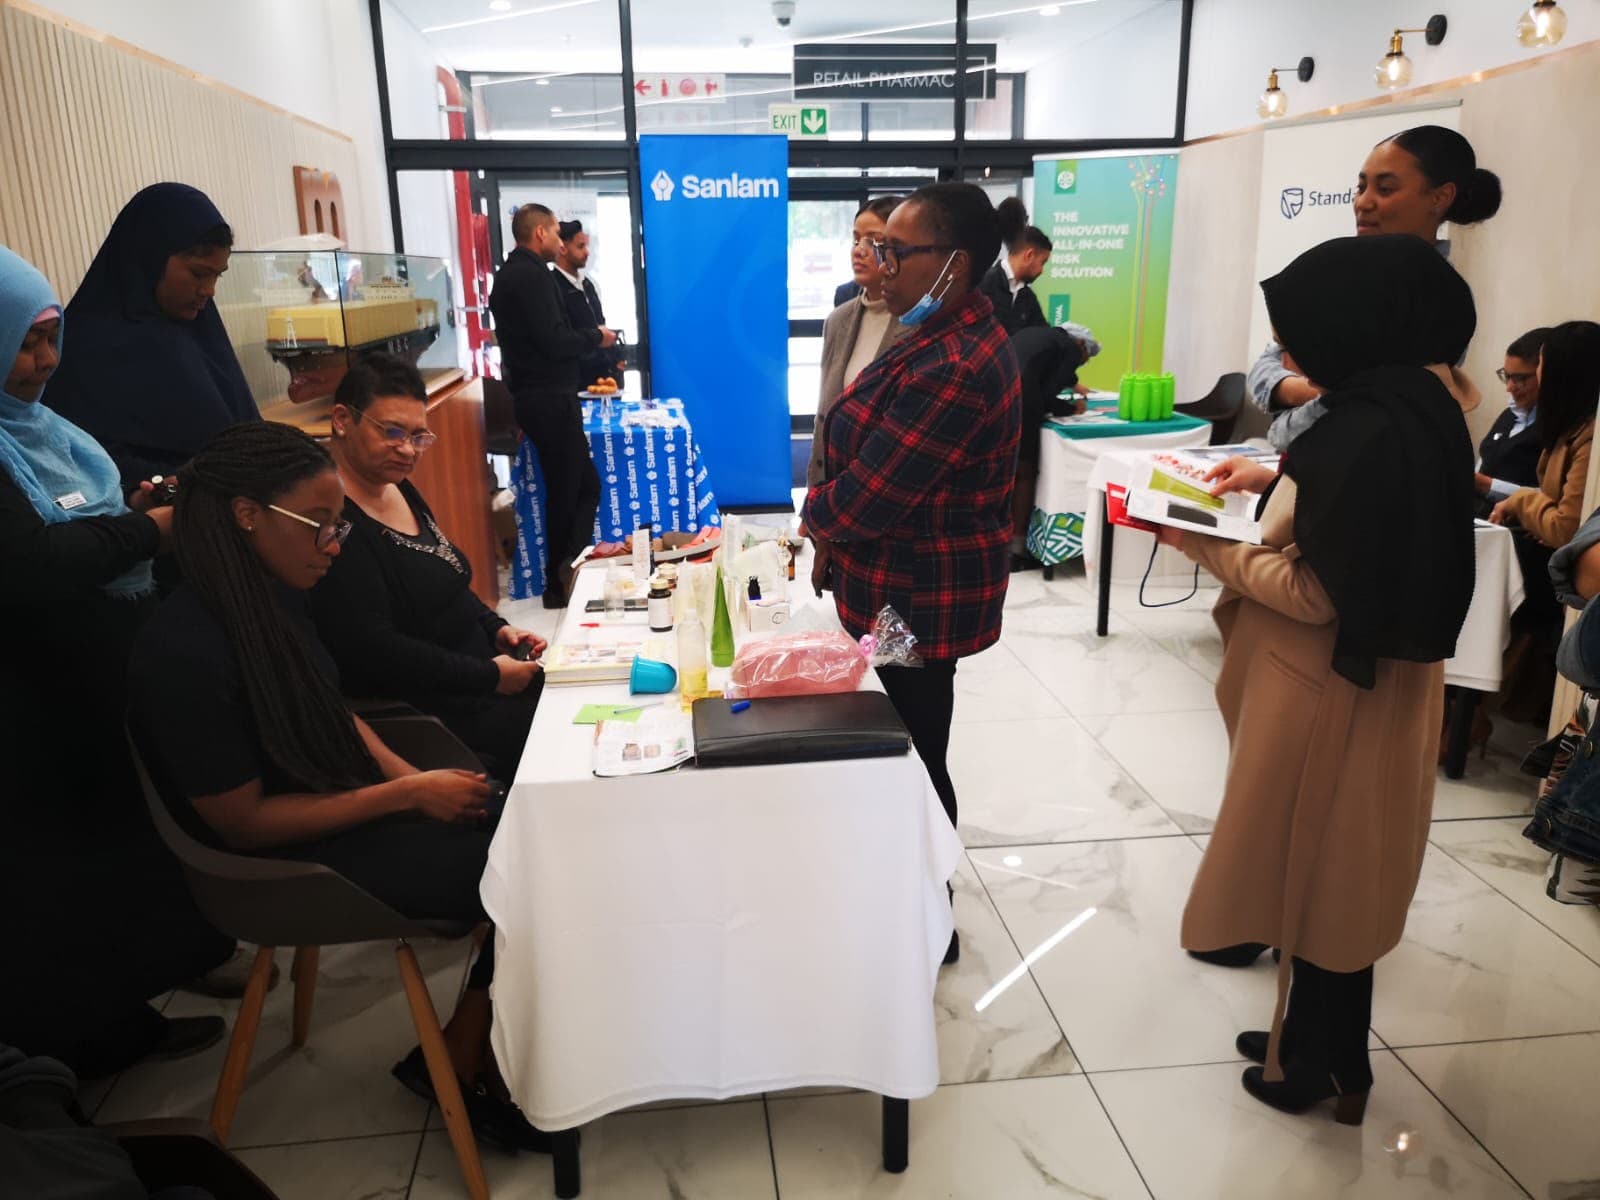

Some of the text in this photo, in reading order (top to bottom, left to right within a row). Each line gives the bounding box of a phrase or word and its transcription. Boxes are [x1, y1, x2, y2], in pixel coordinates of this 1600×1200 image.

[813, 72, 955, 88] RETAIL PHARMAC
[773, 114, 797, 129] EXIT
[682, 172, 779, 199] Sanlam
[1053, 211, 1078, 222] THE
[1053, 224, 1129, 236] INNOVATIVE
[1052, 238, 1125, 250] ALL-IN-ONE
[1050, 266, 1114, 279] SOLUTION
[1051, 253, 1080, 265] RISK
[1054, 304, 1063, 327] TUAL
[604, 433, 616, 473] Sanlam
[627, 460, 639, 499] Sanlam
[667, 456, 678, 495] Sanlam
[609, 487, 621, 526] Sanlam
[650, 484, 661, 522] Sanlam
[688, 482, 697, 521] Sanlam
[530, 496, 543, 535] Sanlam
[517, 528, 530, 568] Sanlam
